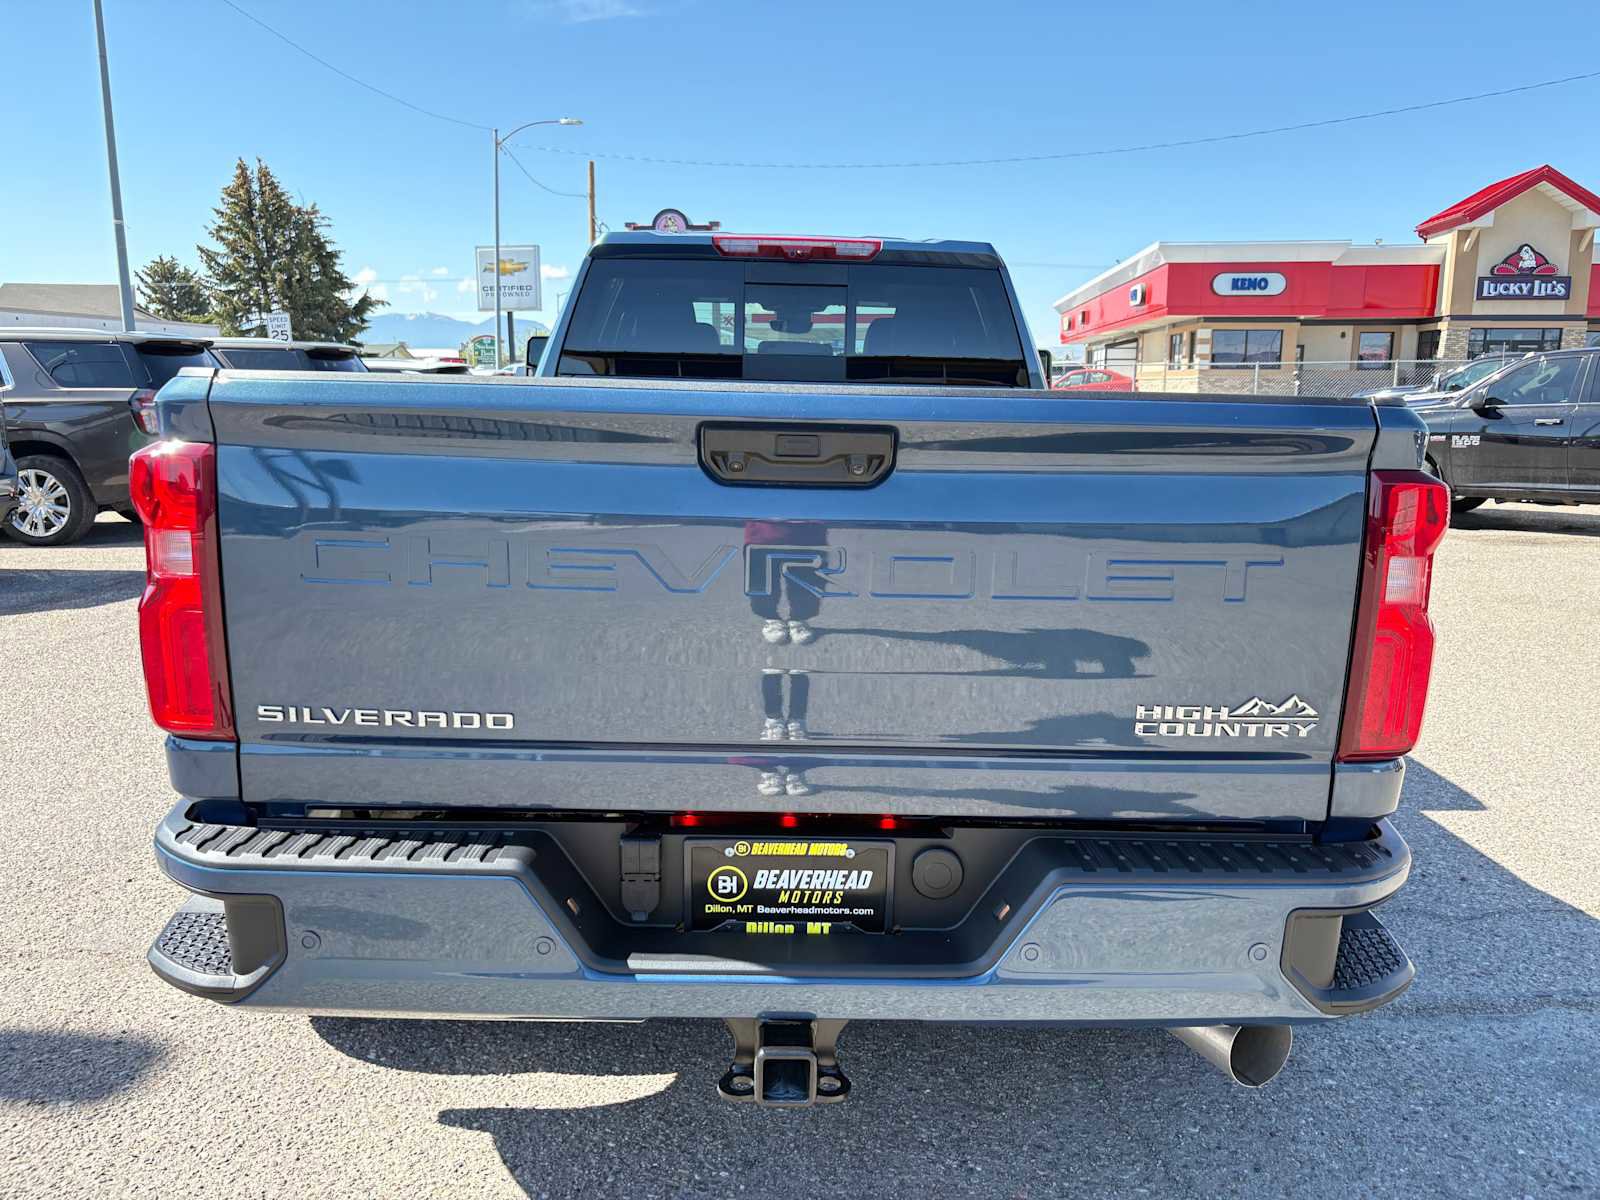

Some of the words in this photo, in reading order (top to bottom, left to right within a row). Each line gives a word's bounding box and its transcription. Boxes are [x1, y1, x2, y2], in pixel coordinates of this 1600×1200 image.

[1231, 278, 1269, 291] KENO
[1482, 280, 1532, 297] LUCKY
[1533, 280, 1567, 297] LIL'S
[271, 330, 289, 341] 25
[301, 535, 1284, 602] CHEVROLET
[257, 705, 514, 729] SILVERADO
[1135, 705, 1229, 720] HIGH
[1134, 722, 1317, 737] COUNTRY
[751, 842, 808, 856] BEAVERHEAD
[808, 843, 848, 857] MOTORS
[753, 869, 873, 890] BEAVERHEAD
[778, 890, 844, 904] MOTORS
[705, 904, 736, 914] Dillon,
[737, 904, 754, 913] MT
[757, 905, 874, 915] Beaverheadmotors.com
[806, 922, 832, 934] MT
